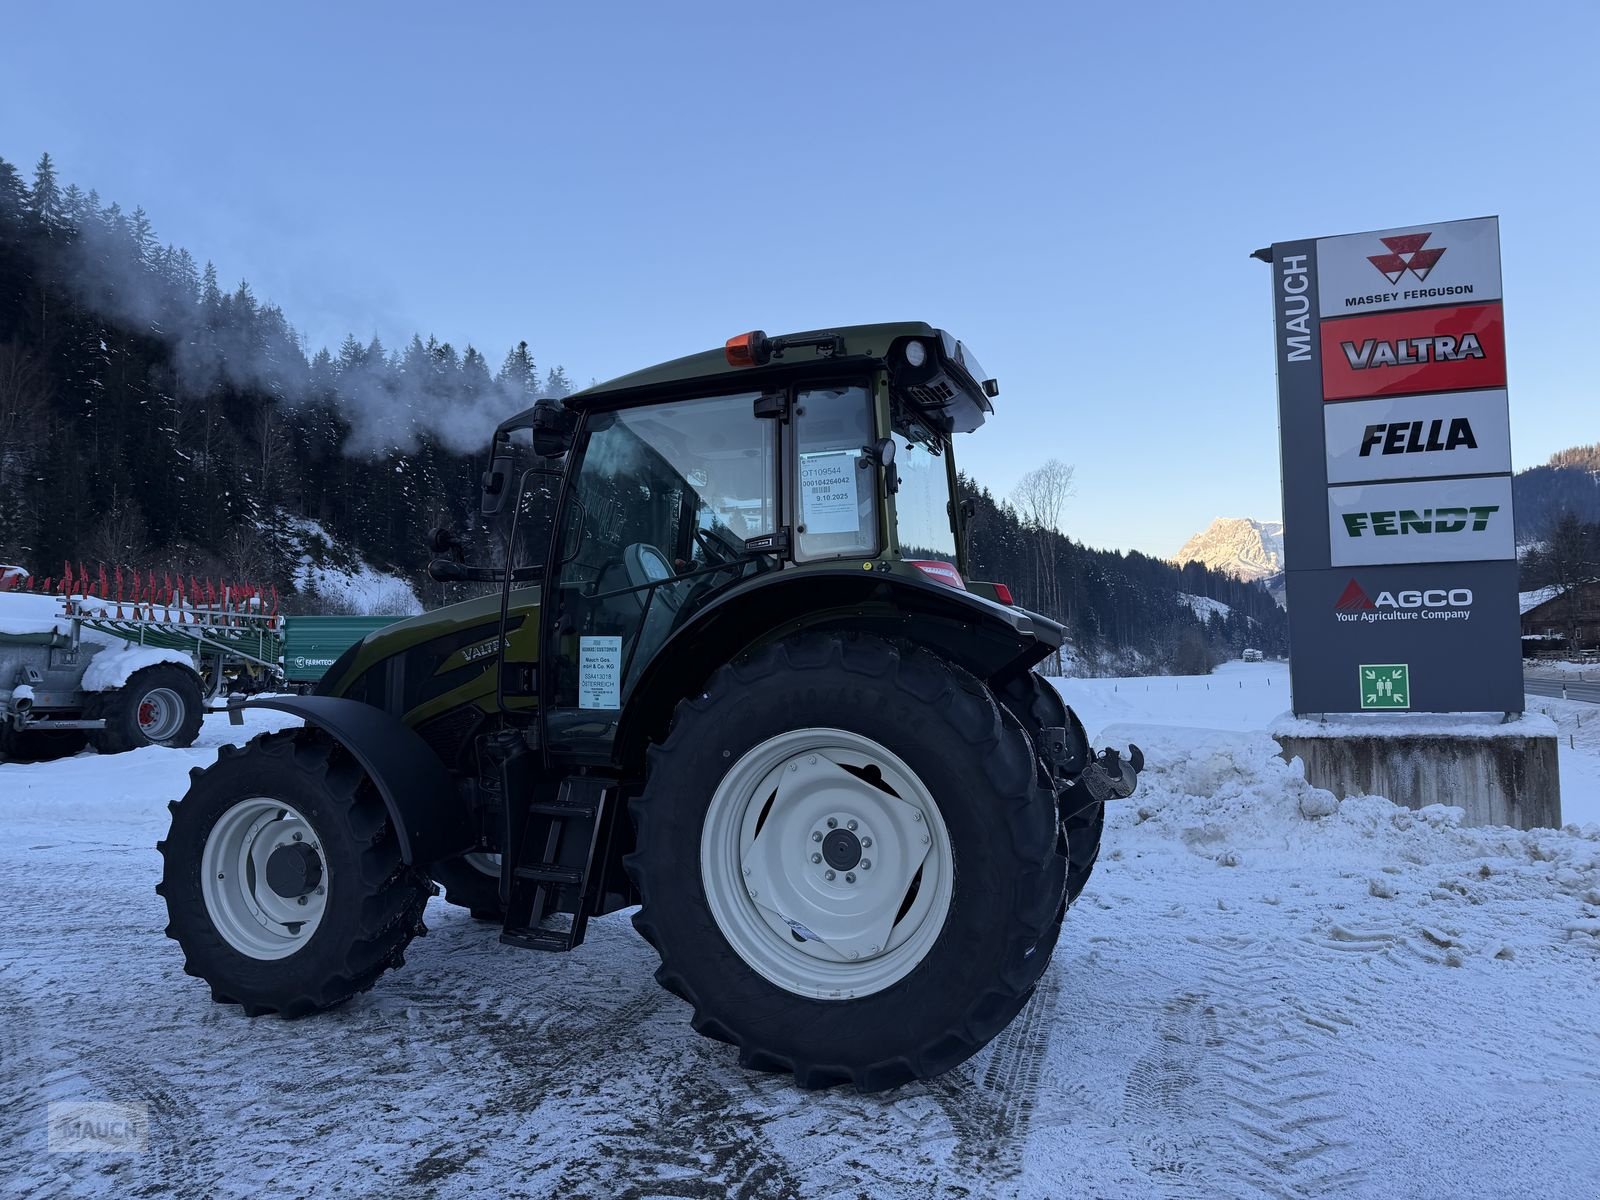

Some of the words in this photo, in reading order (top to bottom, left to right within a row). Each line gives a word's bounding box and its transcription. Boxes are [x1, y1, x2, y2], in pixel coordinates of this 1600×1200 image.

[1283, 254, 1312, 362] MAUCH
[1345, 292, 1399, 306] MASSEY
[1404, 285, 1474, 300] FERGUSON
[1341, 333, 1487, 370] VALTRA
[1359, 418, 1478, 457] FELLA
[1342, 505, 1499, 537] FENDT
[1375, 589, 1473, 608] AGCO
[1336, 612, 1358, 622] Your
[1361, 610, 1418, 623] Agriculture
[1421, 610, 1470, 622] Company
